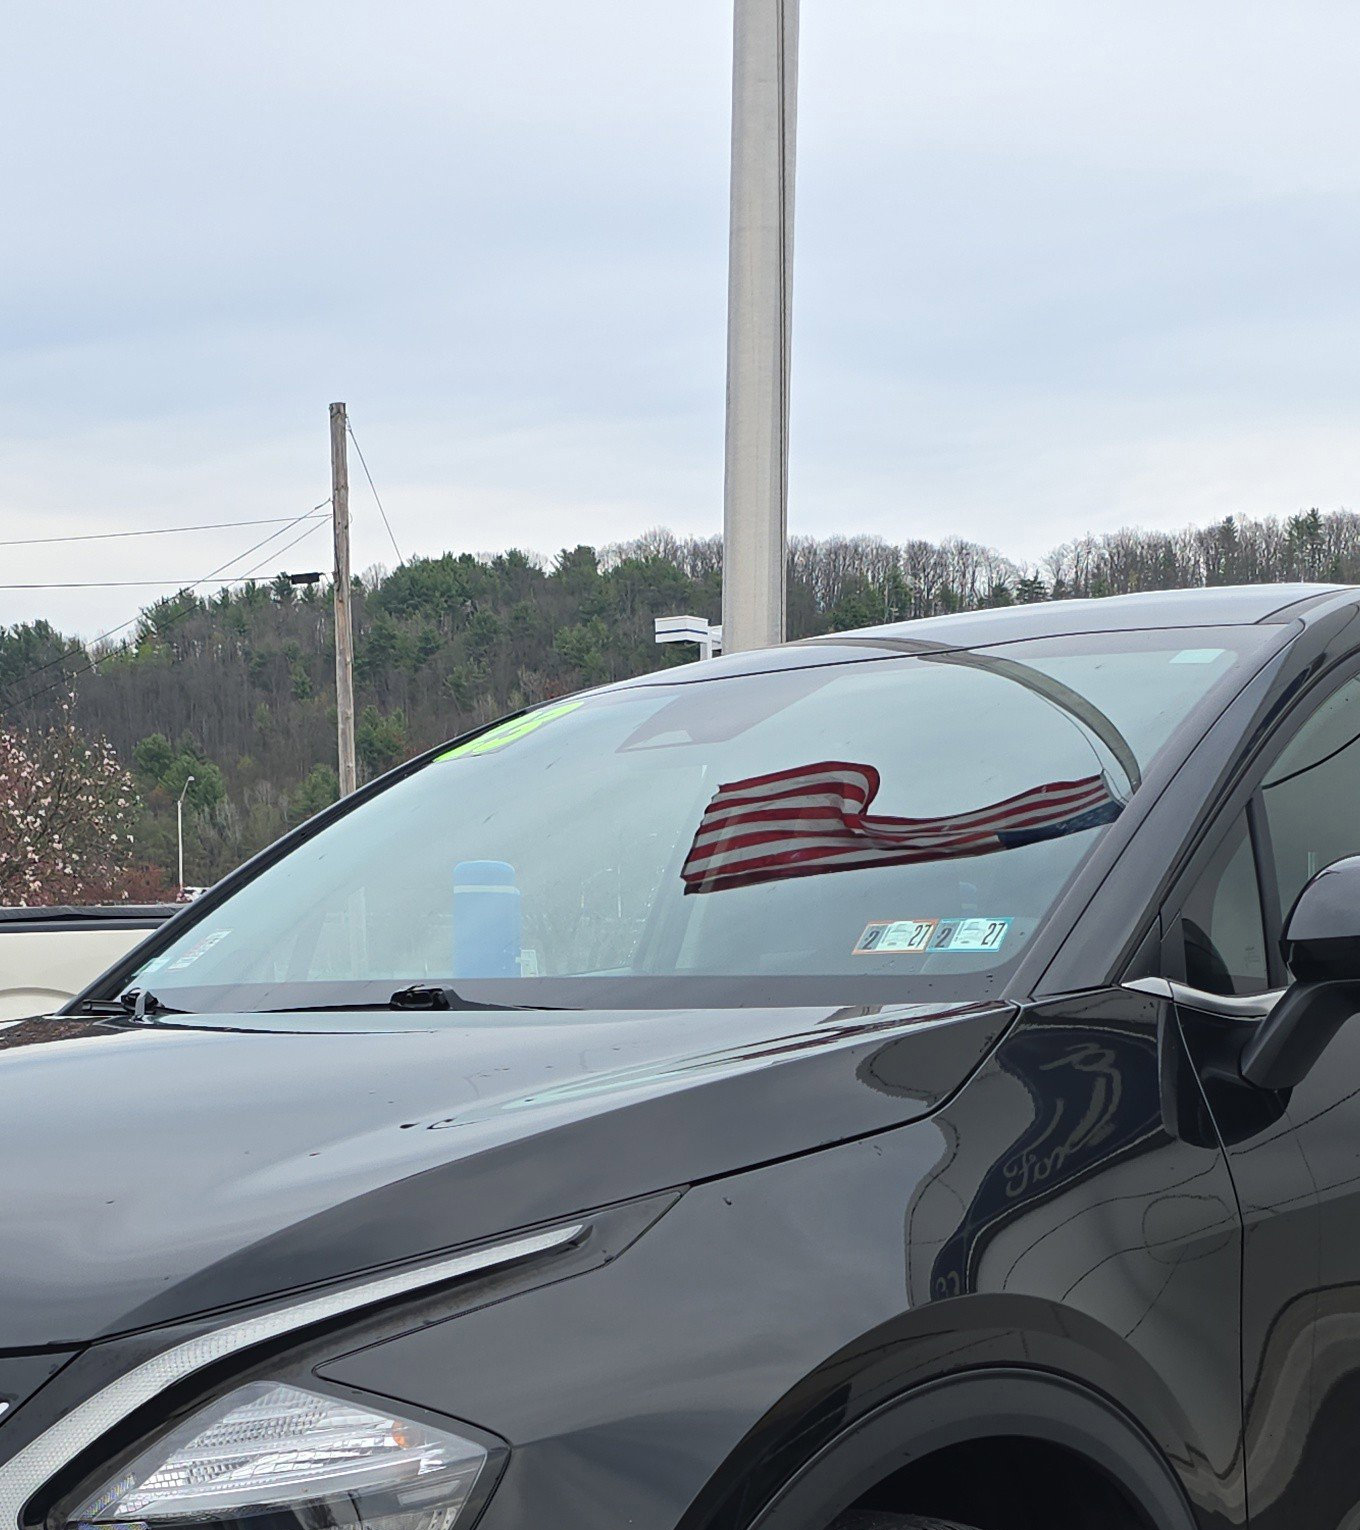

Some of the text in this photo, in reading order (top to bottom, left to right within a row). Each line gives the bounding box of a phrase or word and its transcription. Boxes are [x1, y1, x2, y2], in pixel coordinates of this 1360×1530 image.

[862, 929, 881, 949] 2
[907, 924, 932, 947] 27
[937, 927, 953, 948] 2
[981, 922, 1005, 946] 27
